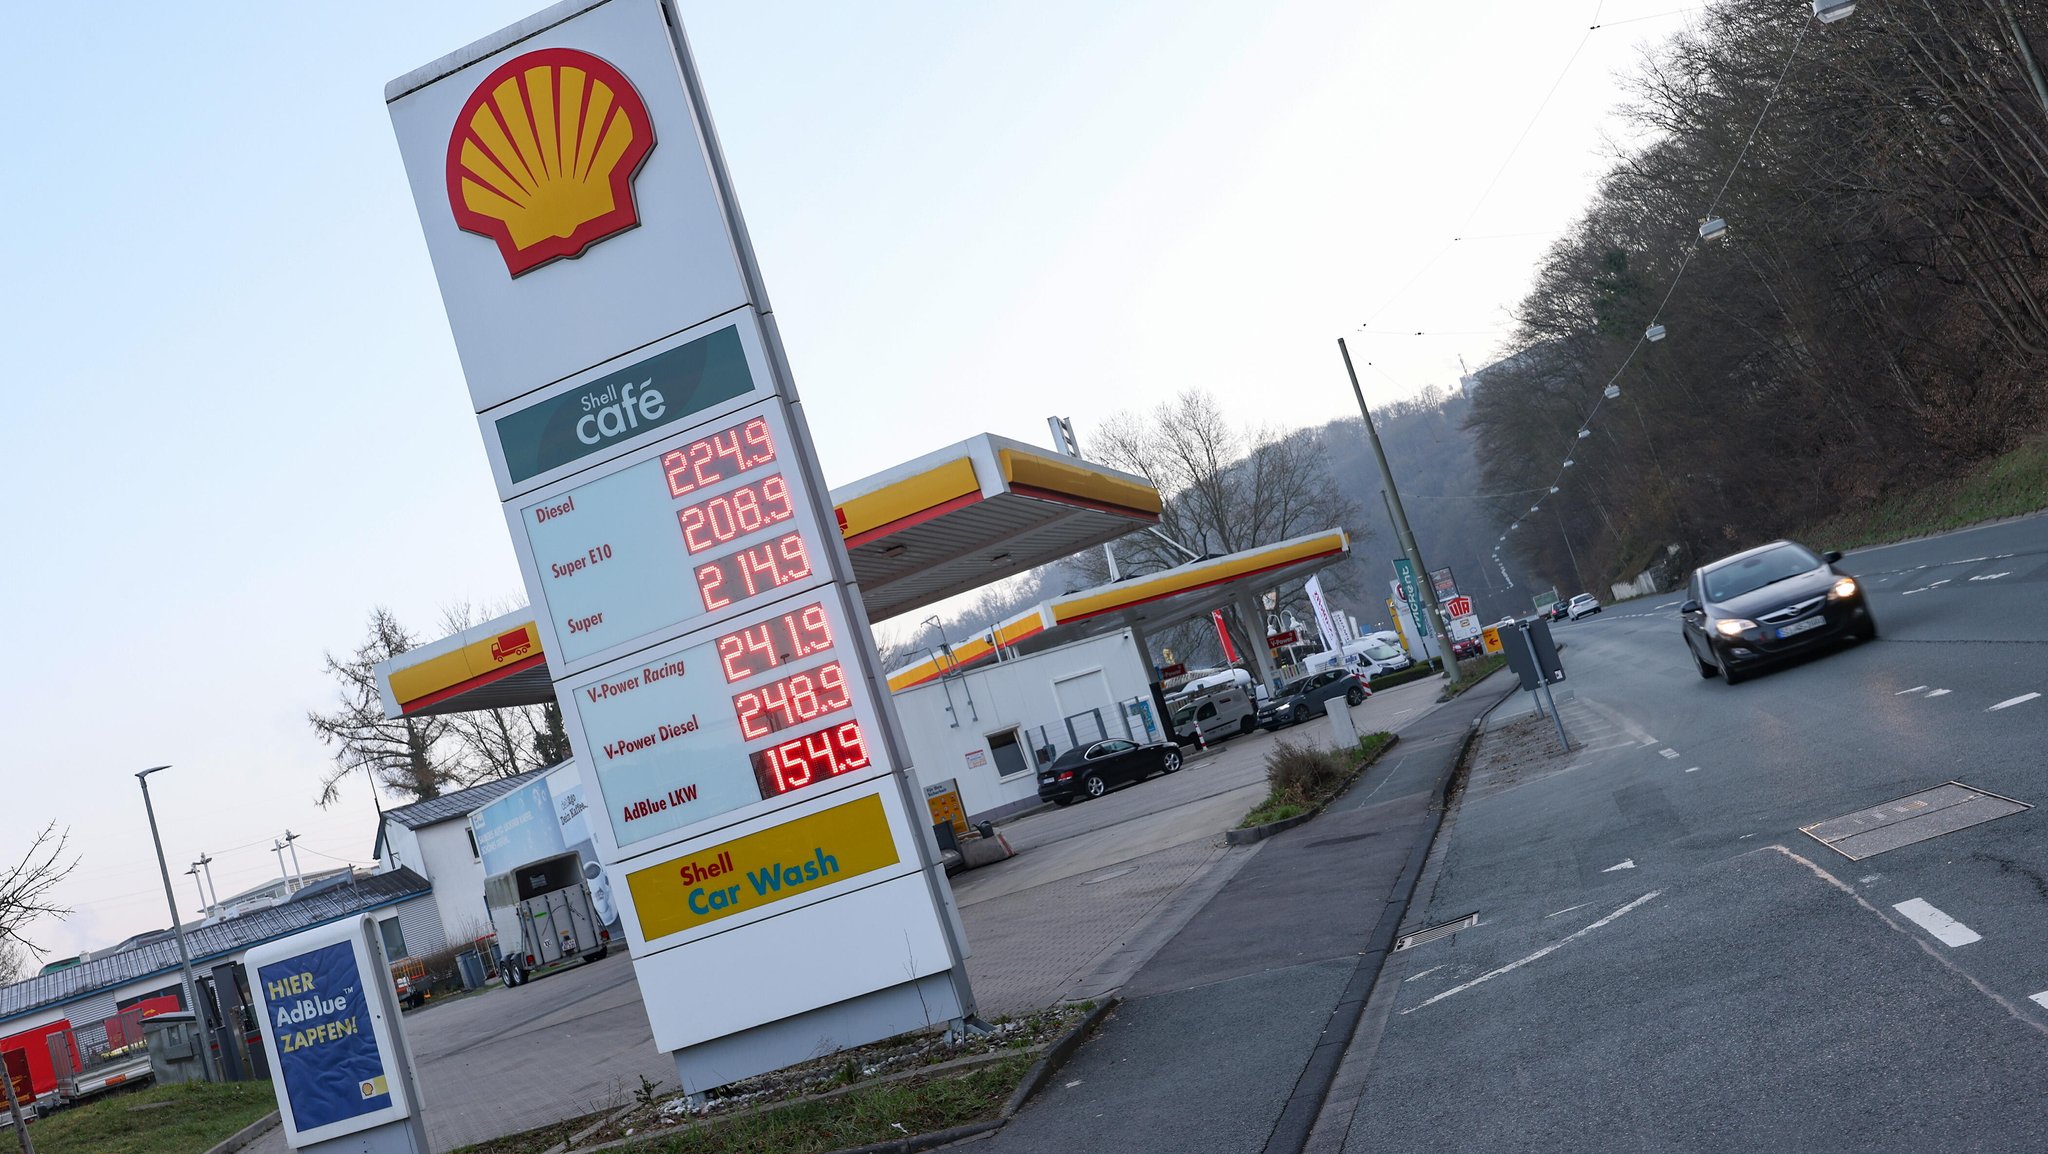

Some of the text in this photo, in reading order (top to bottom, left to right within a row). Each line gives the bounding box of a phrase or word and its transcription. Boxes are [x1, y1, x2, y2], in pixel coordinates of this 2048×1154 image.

[576, 377, 666, 446] café
[581, 384, 617, 411] Shell
[664, 419, 775, 499] 224.9
[536, 497, 575, 524] Diesel
[682, 476, 793, 554] 208.9
[551, 543, 612, 579] Super E10
[699, 534, 811, 611] 214.9
[567, 610, 604, 634] Super
[1448, 597, 1470, 617] UTA
[719, 605, 832, 682] 241.9
[587, 658, 685, 703] V-Power Racing
[736, 664, 850, 740] 248.9
[604, 714, 699, 760] V-Power Diesel
[766, 721, 869, 793] 154.9
[623, 783, 698, 823] AdBlue LKW
[680, 851, 734, 887] Shell
[688, 846, 840, 915] Car Wash
[268, 972, 315, 1001] HIER
[281, 1016, 358, 1053] ZAPFEN!
